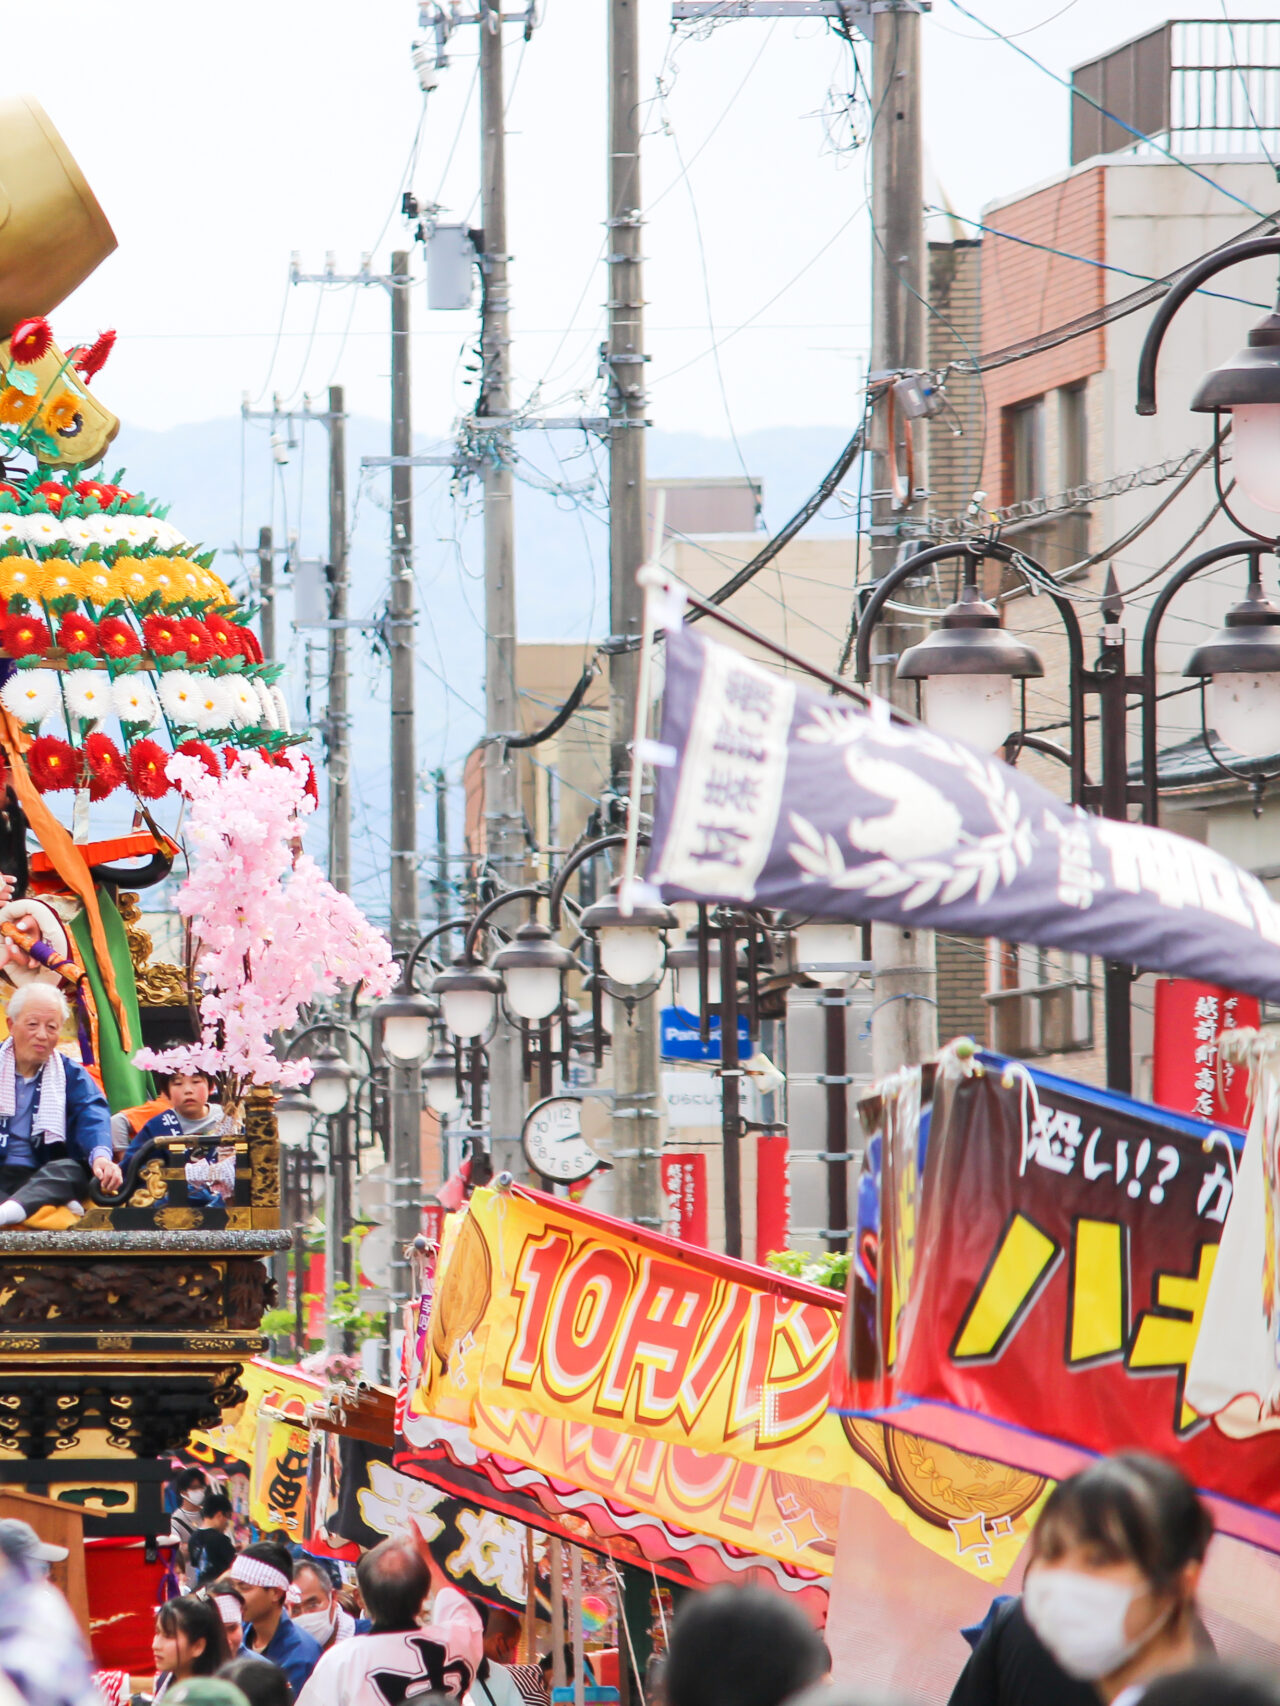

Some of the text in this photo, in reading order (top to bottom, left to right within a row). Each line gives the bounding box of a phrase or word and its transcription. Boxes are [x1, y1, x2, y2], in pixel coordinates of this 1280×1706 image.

[1191, 996, 1219, 1124] 越前町商店
